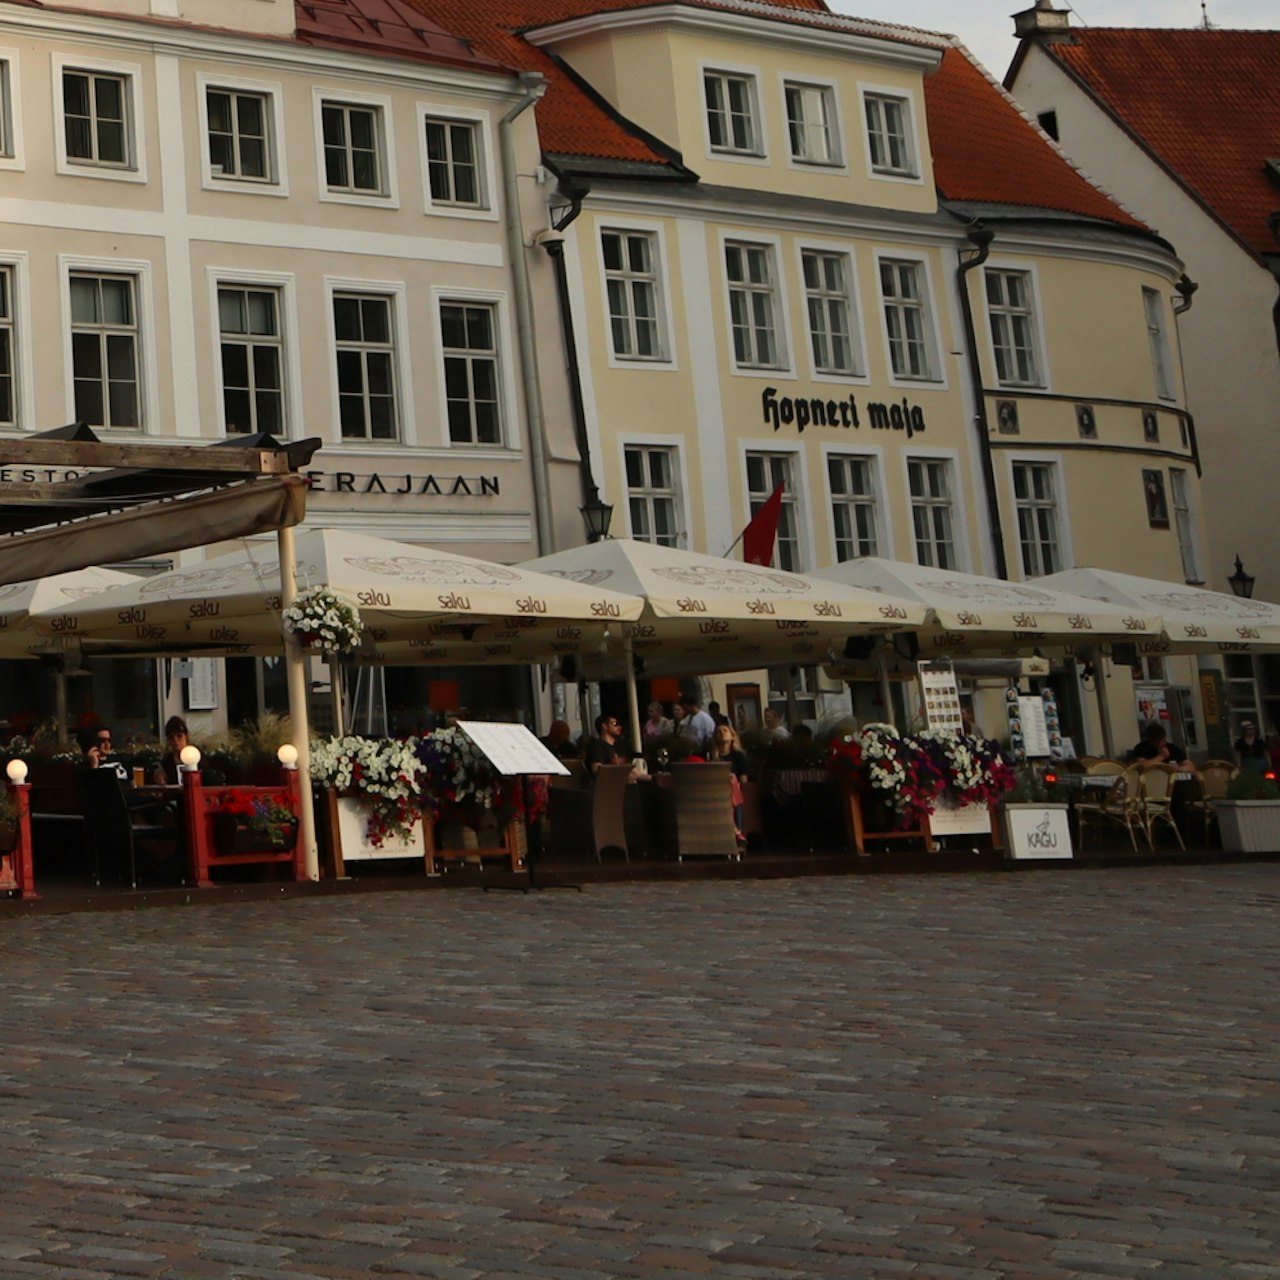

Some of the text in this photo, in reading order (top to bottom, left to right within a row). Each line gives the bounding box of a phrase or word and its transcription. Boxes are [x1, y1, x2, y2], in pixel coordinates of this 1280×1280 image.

[867, 397, 925, 439] maja
[265, 596, 282, 611] sa
[357, 588, 391, 607] saku
[438, 591, 471, 610] saku
[515, 595, 547, 614] saku
[676, 596, 707, 613] saku
[189, 600, 220, 618] saku
[590, 599, 620, 617] saku
[745, 598, 776, 615] saku
[813, 601, 843, 617] saku
[878, 603, 907, 620] saku
[50, 615, 78, 632] saku
[117, 607, 147, 625] saku
[957, 610, 982, 625] saku
[1012, 612, 1038, 628] saku
[1067, 614, 1093, 630] saku
[1122, 615, 1146, 631] saku
[1184, 623, 1208, 638] saku
[1236, 625, 1261, 640] saku
[1027, 832, 1057, 848] KAGU
